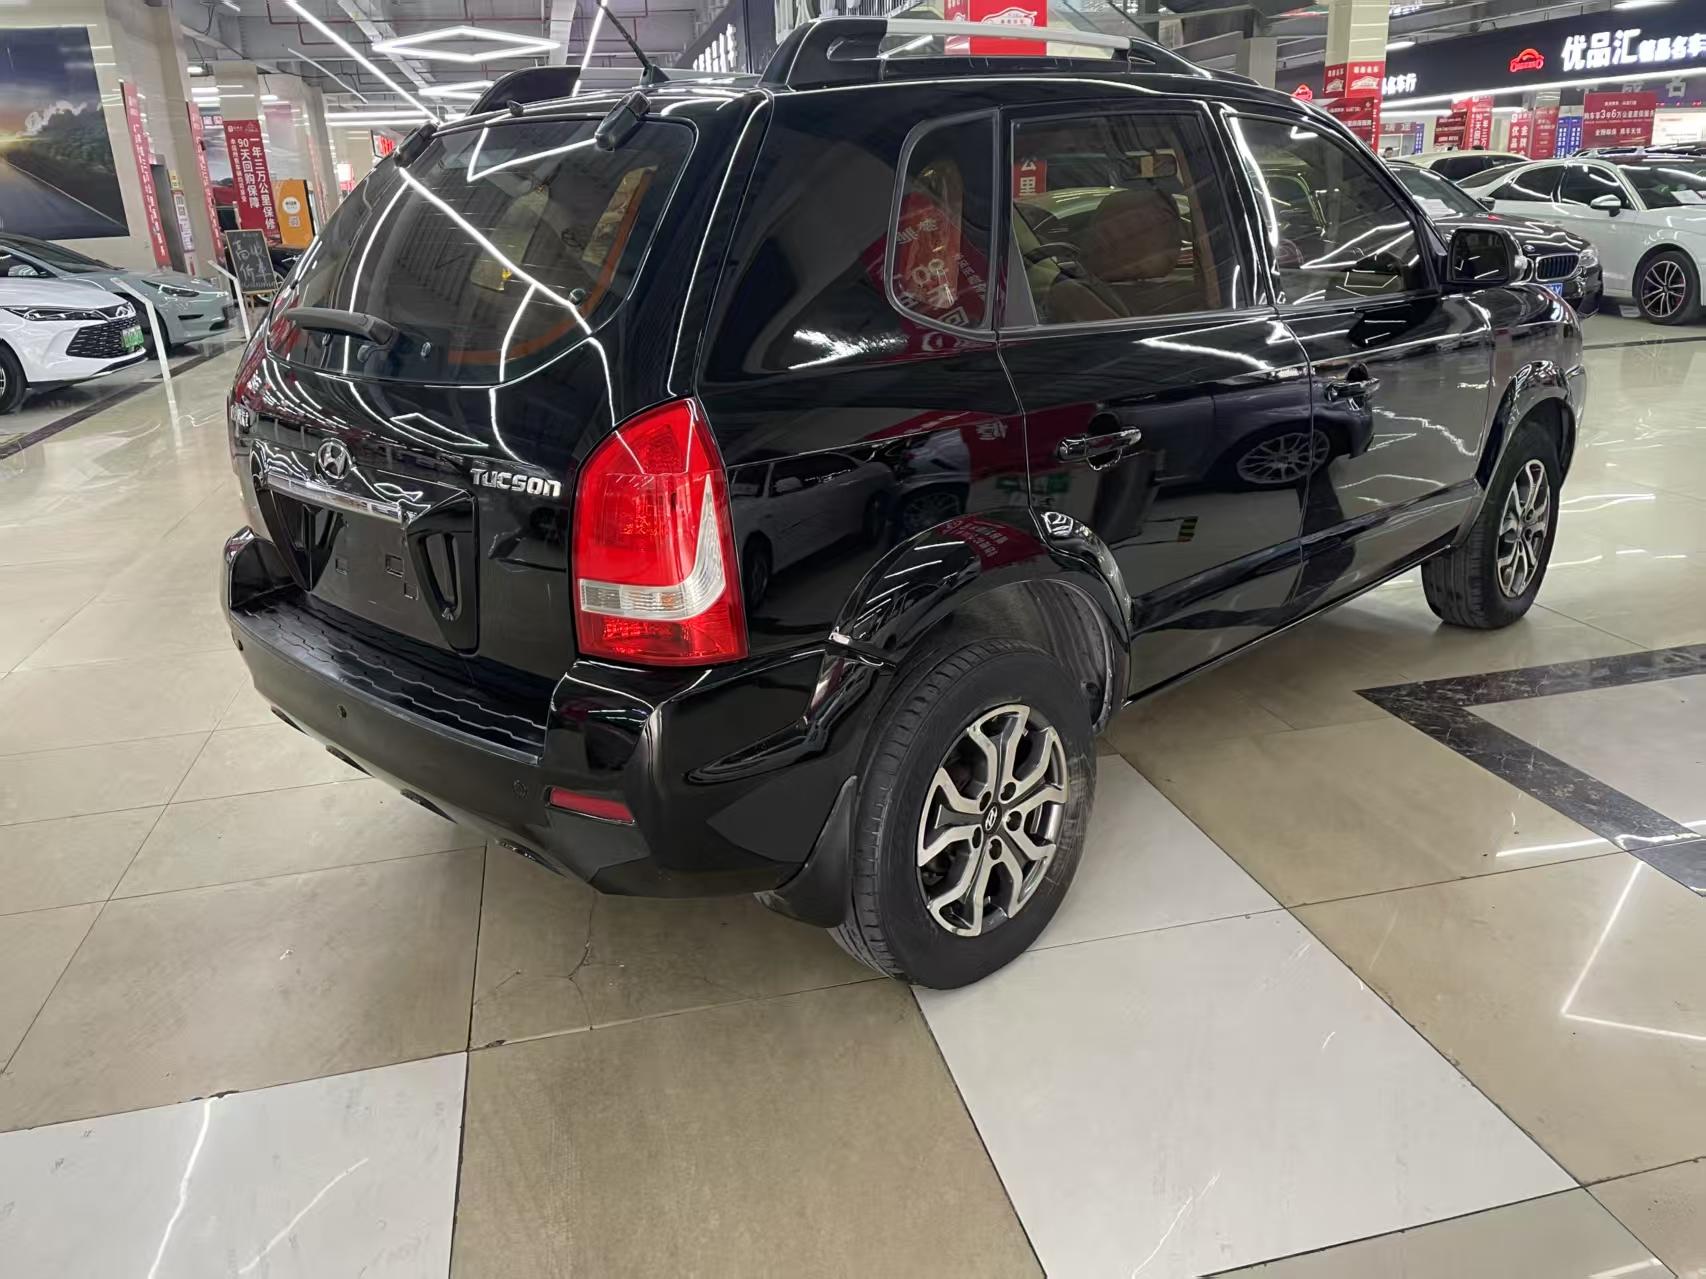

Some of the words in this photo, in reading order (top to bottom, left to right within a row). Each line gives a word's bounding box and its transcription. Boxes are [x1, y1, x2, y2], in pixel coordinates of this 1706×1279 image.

[237, 138, 260, 209] 90天回购保障
[249, 138, 275, 230] 一年三万公里保修
[470, 468, 562, 497] TUCSON
